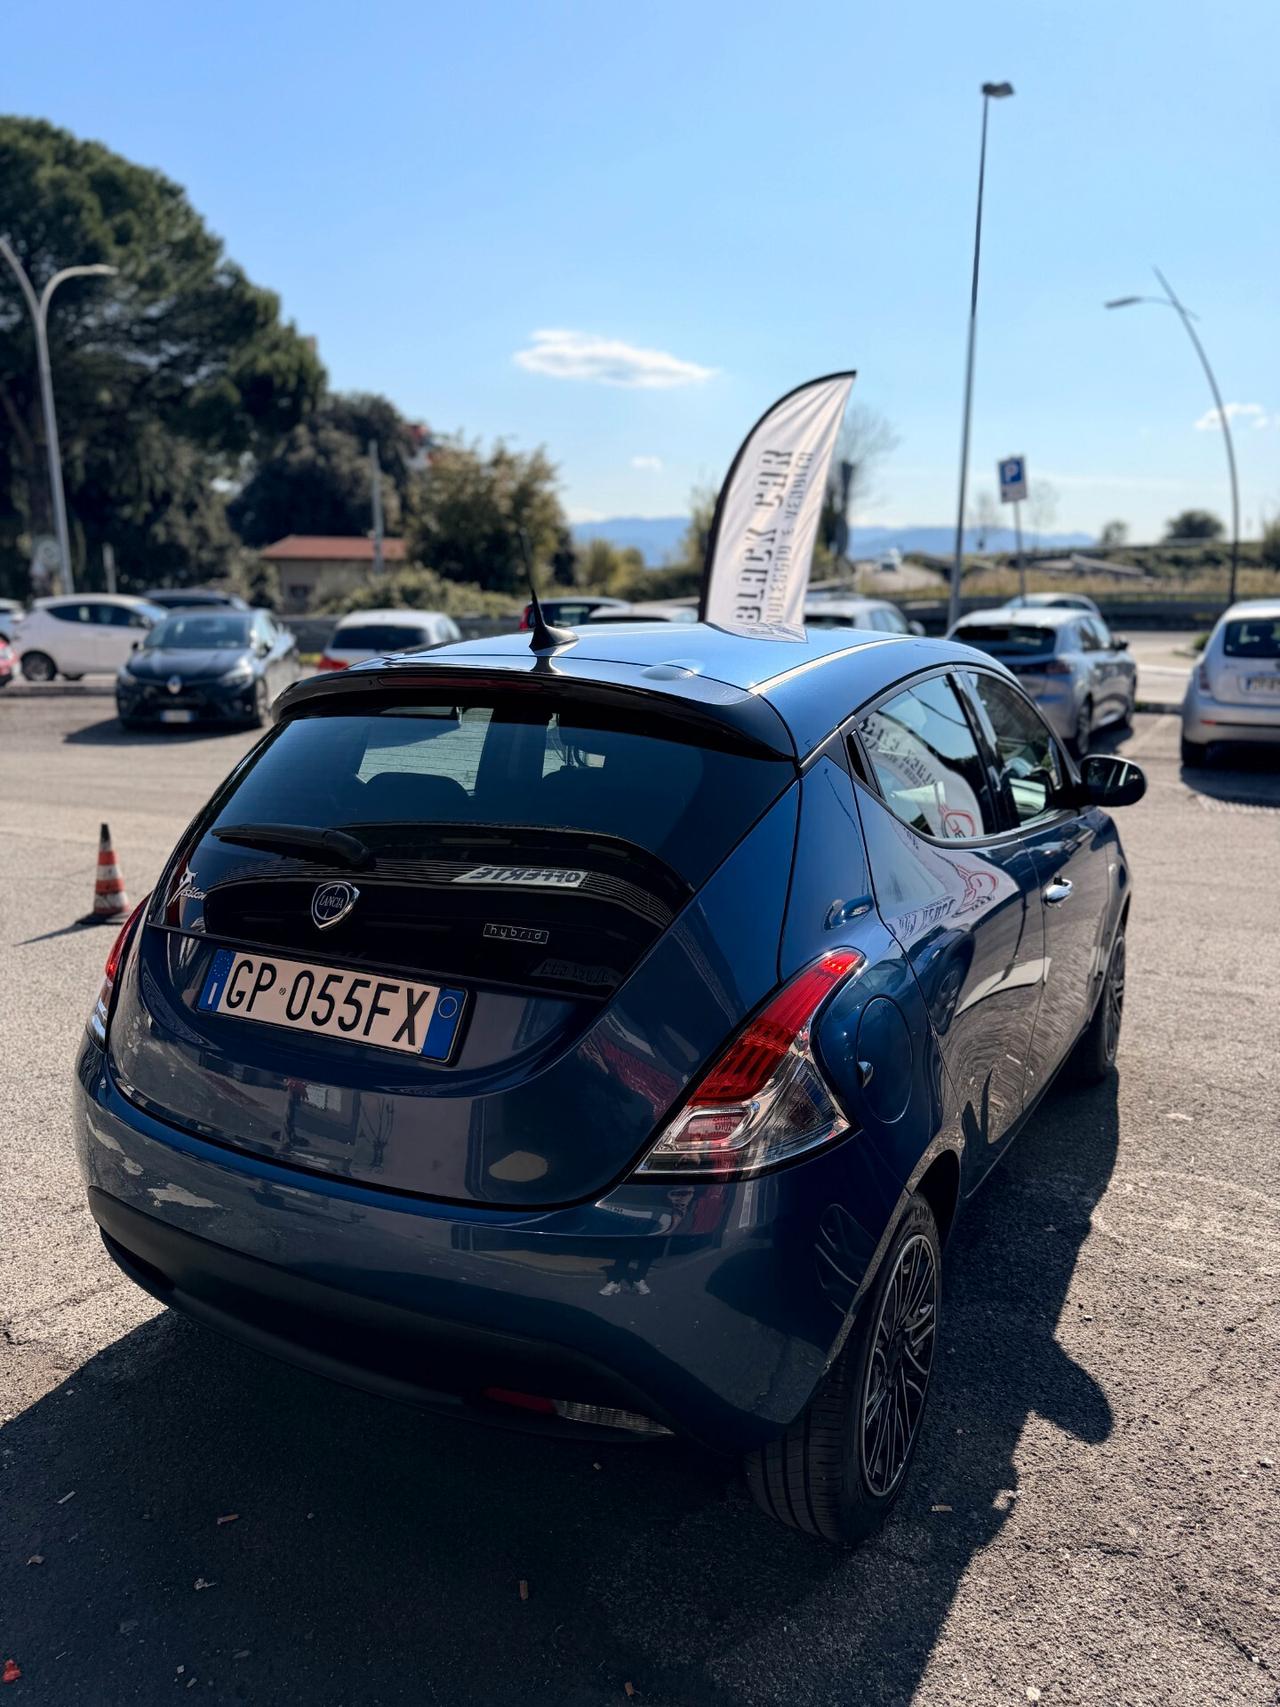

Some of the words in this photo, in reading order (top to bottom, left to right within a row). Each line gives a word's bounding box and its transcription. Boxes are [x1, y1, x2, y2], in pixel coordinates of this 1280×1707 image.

[1005, 464, 1019, 482] P
[733, 528, 777, 623] BLACK
[755, 450, 793, 508] CAR
[319, 894, 345, 909] LANCIA
[488, 925, 543, 941] hybrid
[225, 959, 278, 1013] GP
[285, 969, 431, 1047] 055FX
